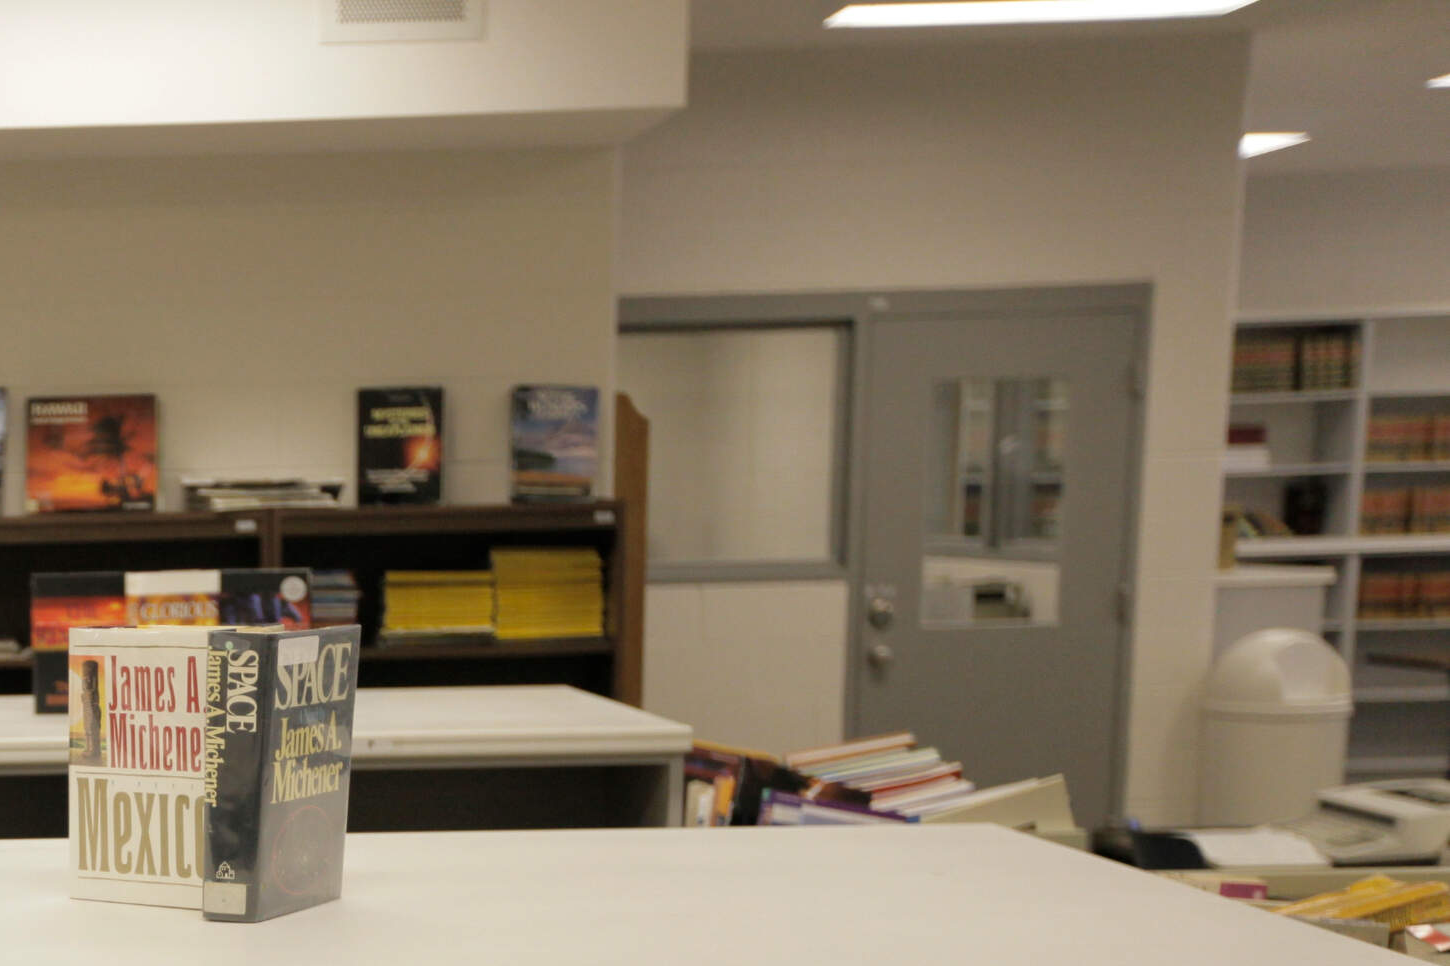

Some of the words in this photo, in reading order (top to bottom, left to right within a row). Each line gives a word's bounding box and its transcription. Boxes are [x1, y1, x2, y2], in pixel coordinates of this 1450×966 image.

[109, 655, 176, 713] James
[225, 650, 260, 733] SPACE
[273, 643, 351, 711] SPACE
[109, 713, 202, 773] Michene
[204, 729, 226, 807] Michener
[275, 717, 324, 763] James
[270, 760, 343, 804] Michener
